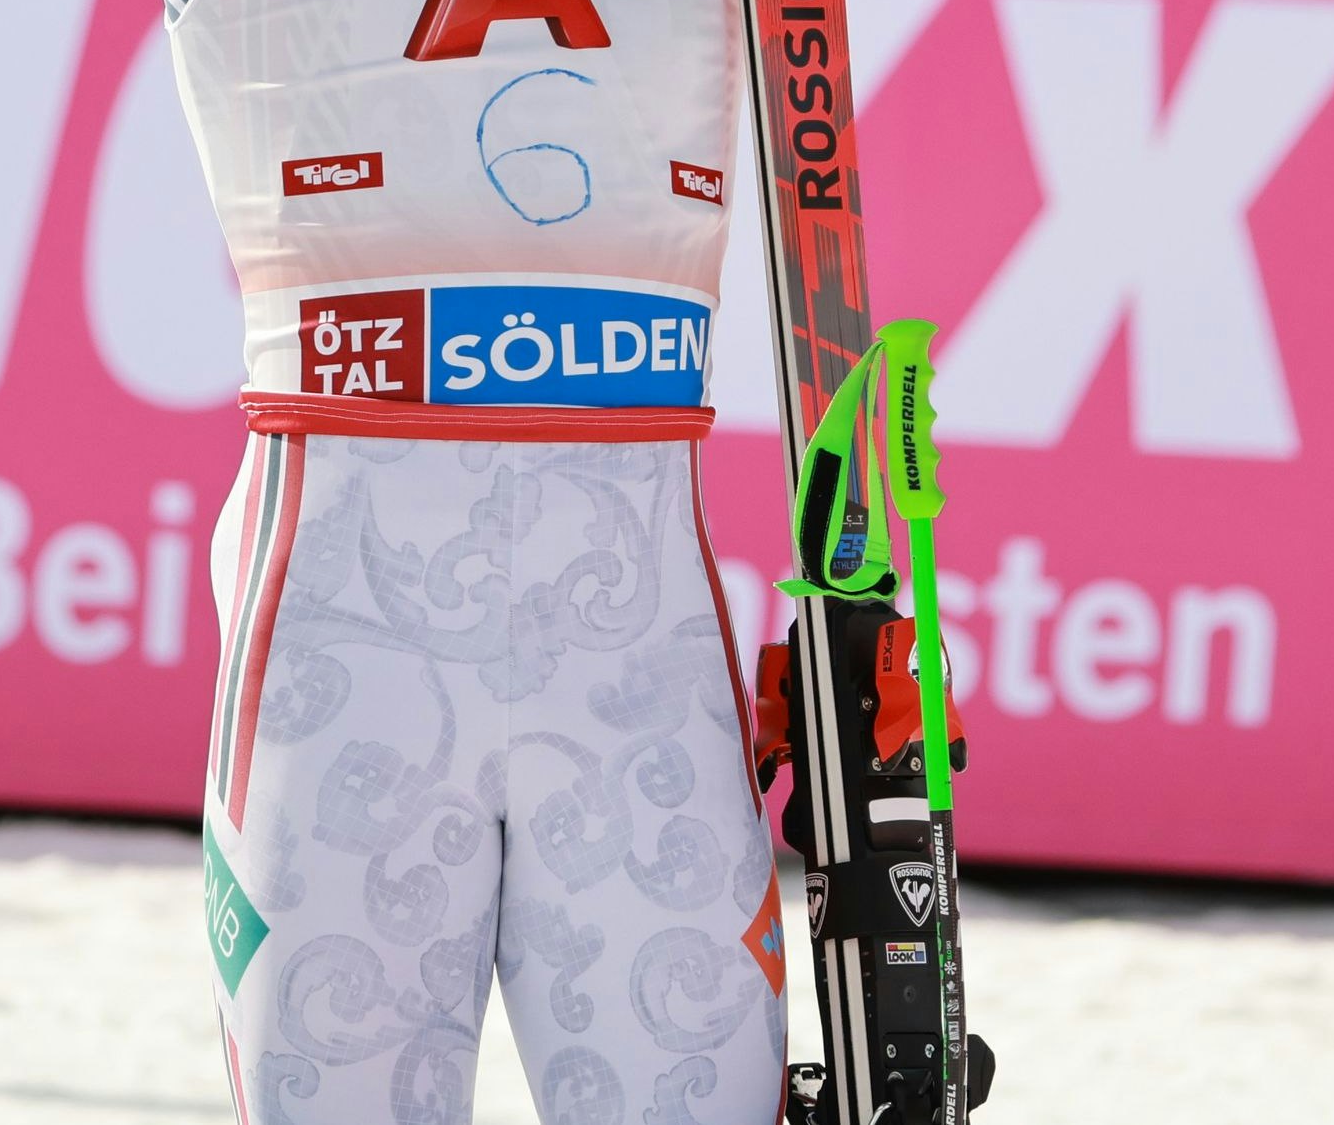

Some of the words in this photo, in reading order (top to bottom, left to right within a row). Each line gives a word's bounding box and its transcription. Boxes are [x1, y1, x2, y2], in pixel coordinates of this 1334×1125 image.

[475, 67, 598, 227] 6
[294, 159, 371, 188] Tirol
[314, 309, 404, 356] ÖTZ
[441, 312, 710, 391] SÖLDEN
[314, 359, 404, 395] TAL
[907, 364, 920, 492] KOMPERDELL
[832, 560, 863, 571] ATHLET
[933, 823, 950, 916] KOMPERDELL
[888, 952, 915, 963] LOOK
